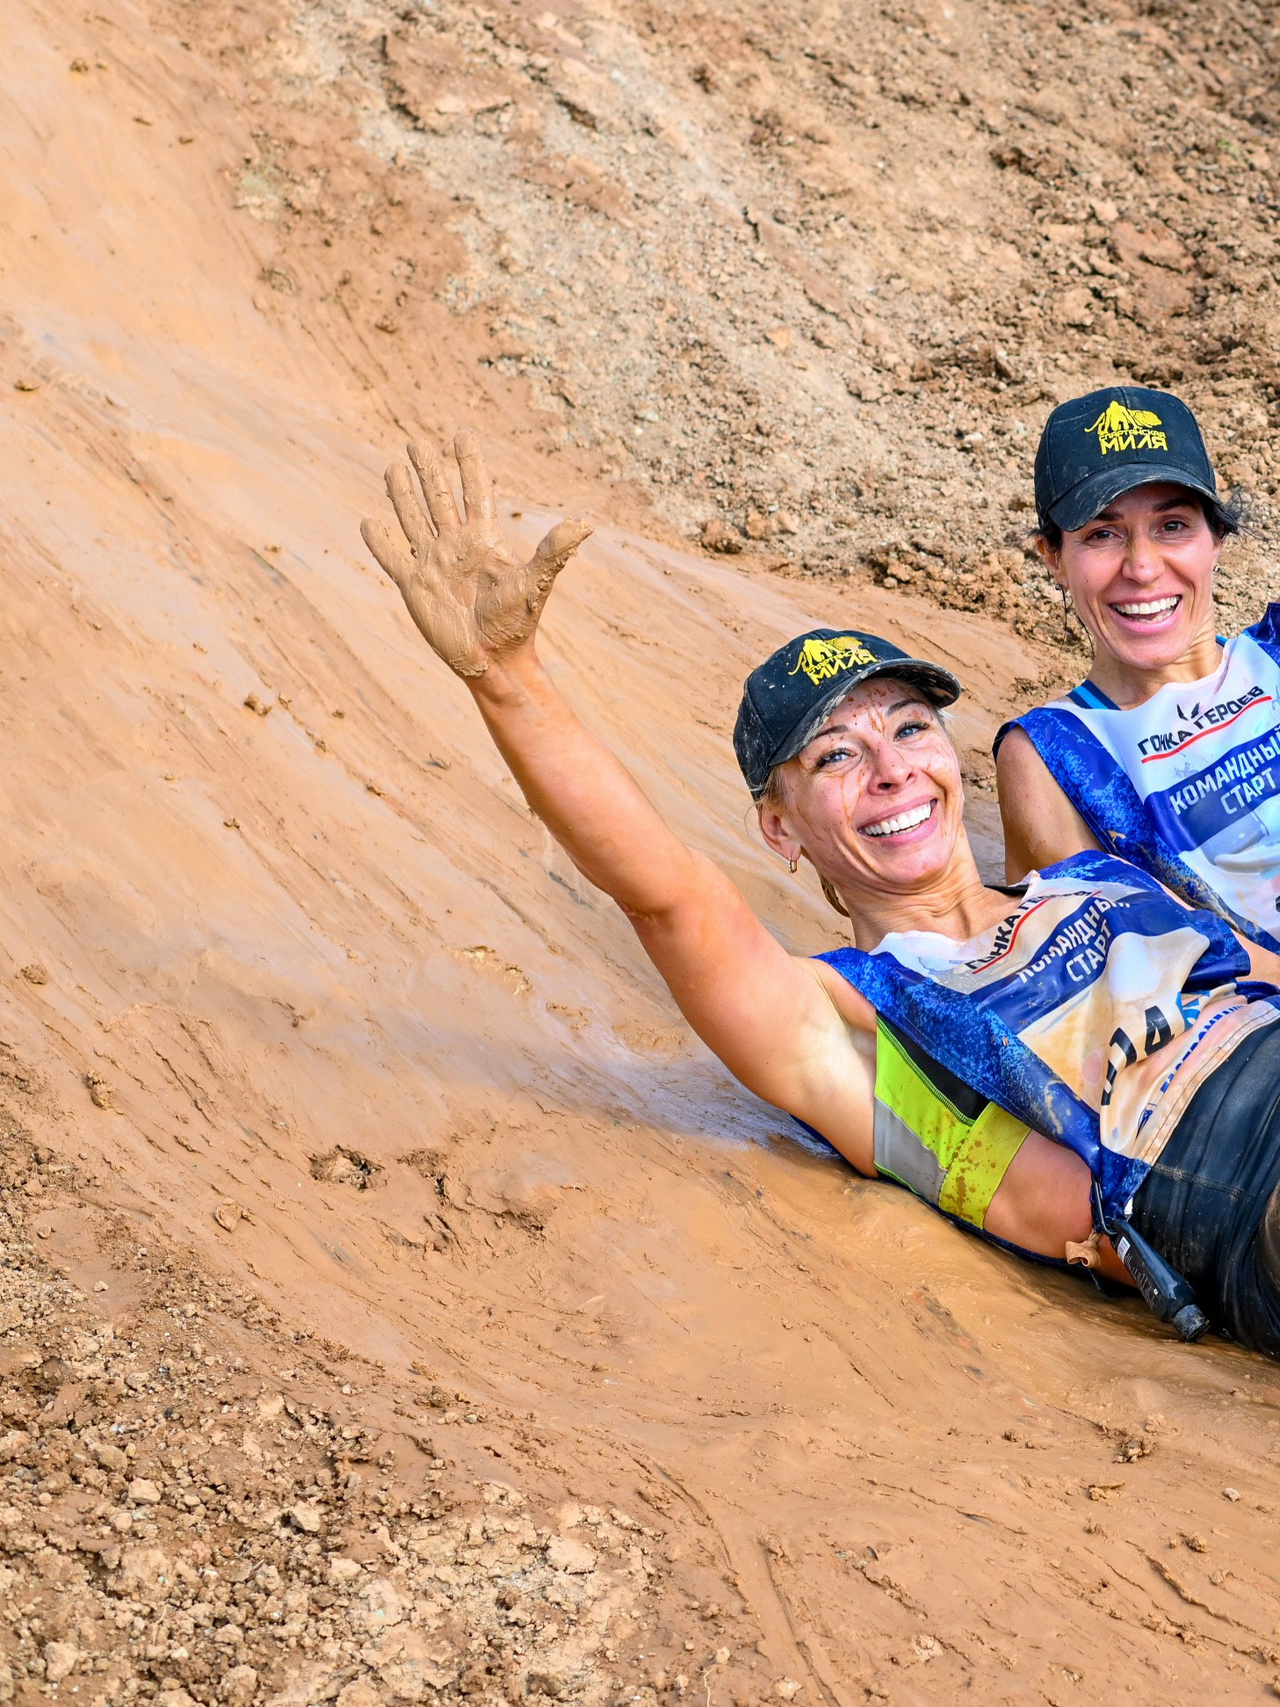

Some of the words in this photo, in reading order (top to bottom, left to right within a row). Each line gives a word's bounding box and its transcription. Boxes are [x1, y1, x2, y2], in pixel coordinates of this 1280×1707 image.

[1099, 434, 1169, 455] МИЛЯ
[808, 651, 878, 686] МИЛЯ
[1193, 685, 1264, 730] ГЕРОЕВ
[1220, 767, 1278, 815] СТАРТ
[1066, 919, 1111, 983] СТАРТ
